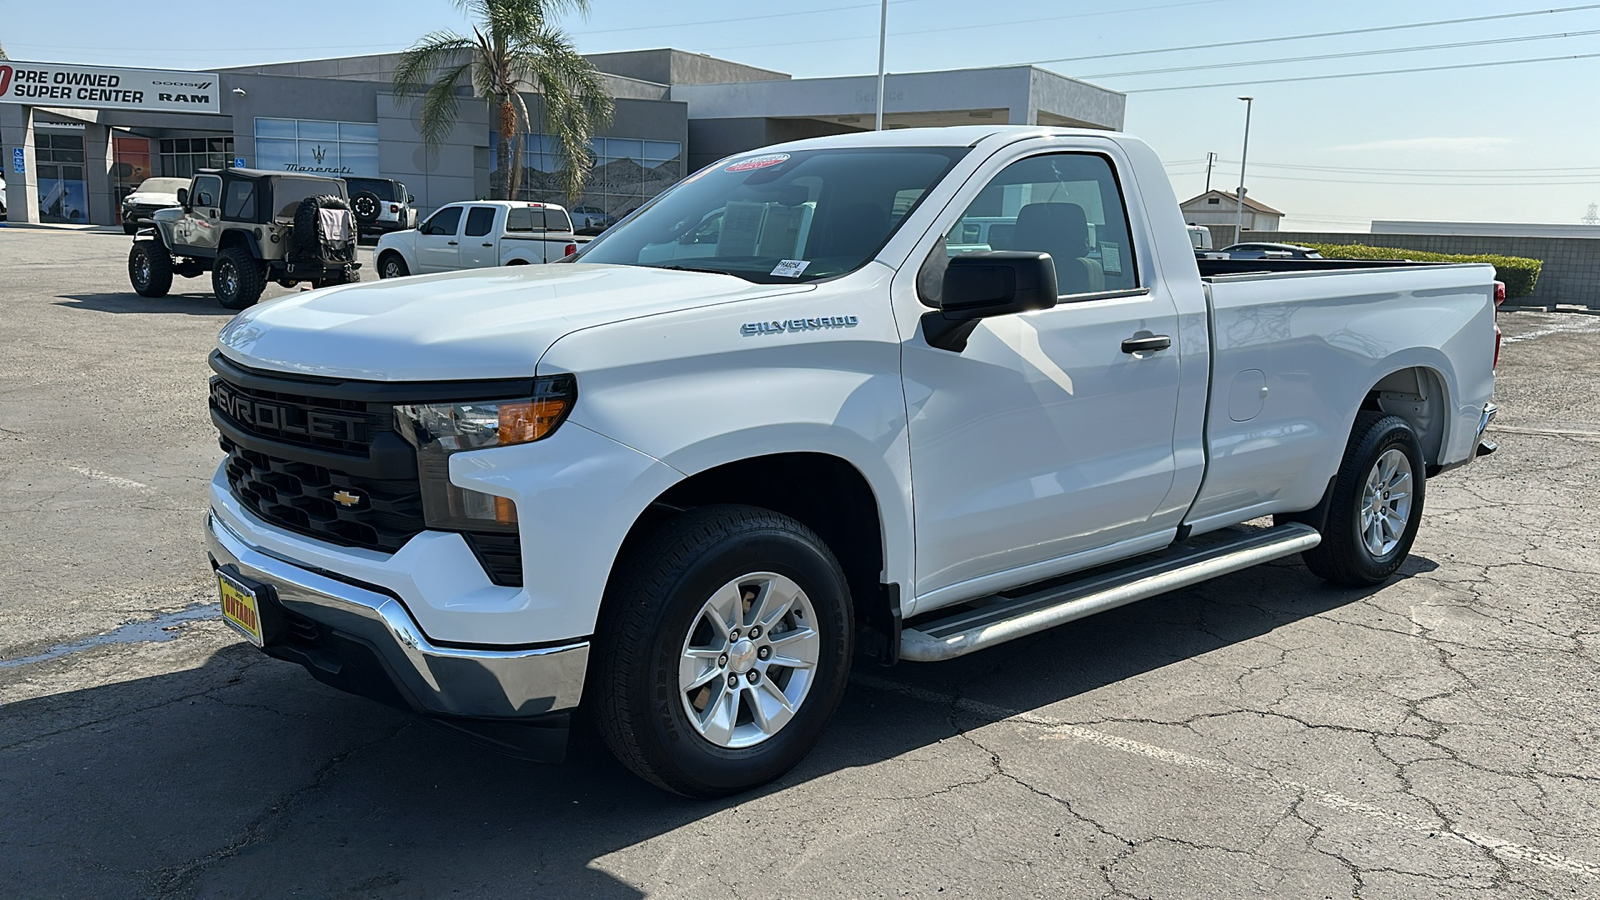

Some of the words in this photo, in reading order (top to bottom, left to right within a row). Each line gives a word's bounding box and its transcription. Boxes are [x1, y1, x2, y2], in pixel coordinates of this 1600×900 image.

[14, 70, 49, 84] PRE
[53, 72, 120, 88] OWNED
[14, 84, 71, 99] SUPER
[77, 88, 144, 103] CENTER
[158, 93, 209, 103] RAM
[284, 163, 354, 174] Maserati
[740, 316, 858, 337] SILVERADO
[211, 382, 365, 441] HEVROLET
[225, 593, 256, 630] ONTARIO
